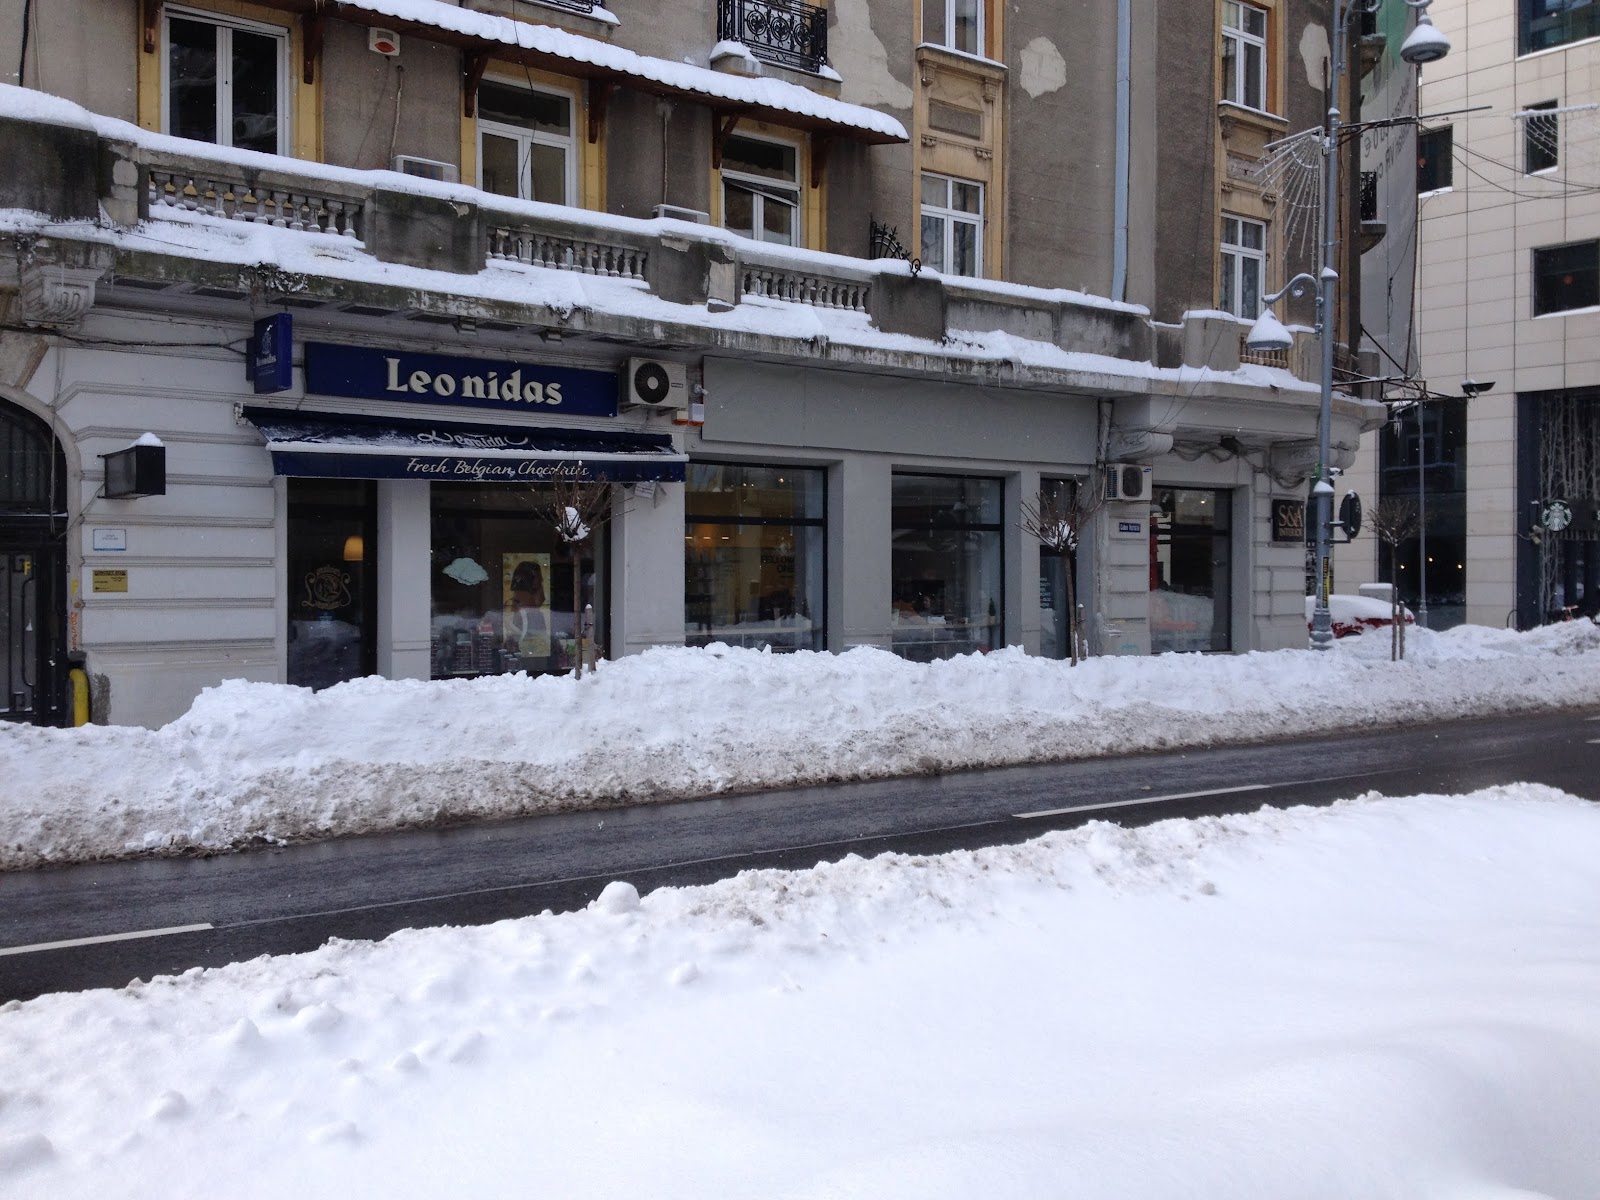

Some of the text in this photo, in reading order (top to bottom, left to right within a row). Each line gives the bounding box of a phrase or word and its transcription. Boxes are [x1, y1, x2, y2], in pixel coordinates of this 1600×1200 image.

[385, 357, 563, 405] Leonidas
[406, 458, 450, 474] Fresh
[454, 459, 512, 480] Belgian
